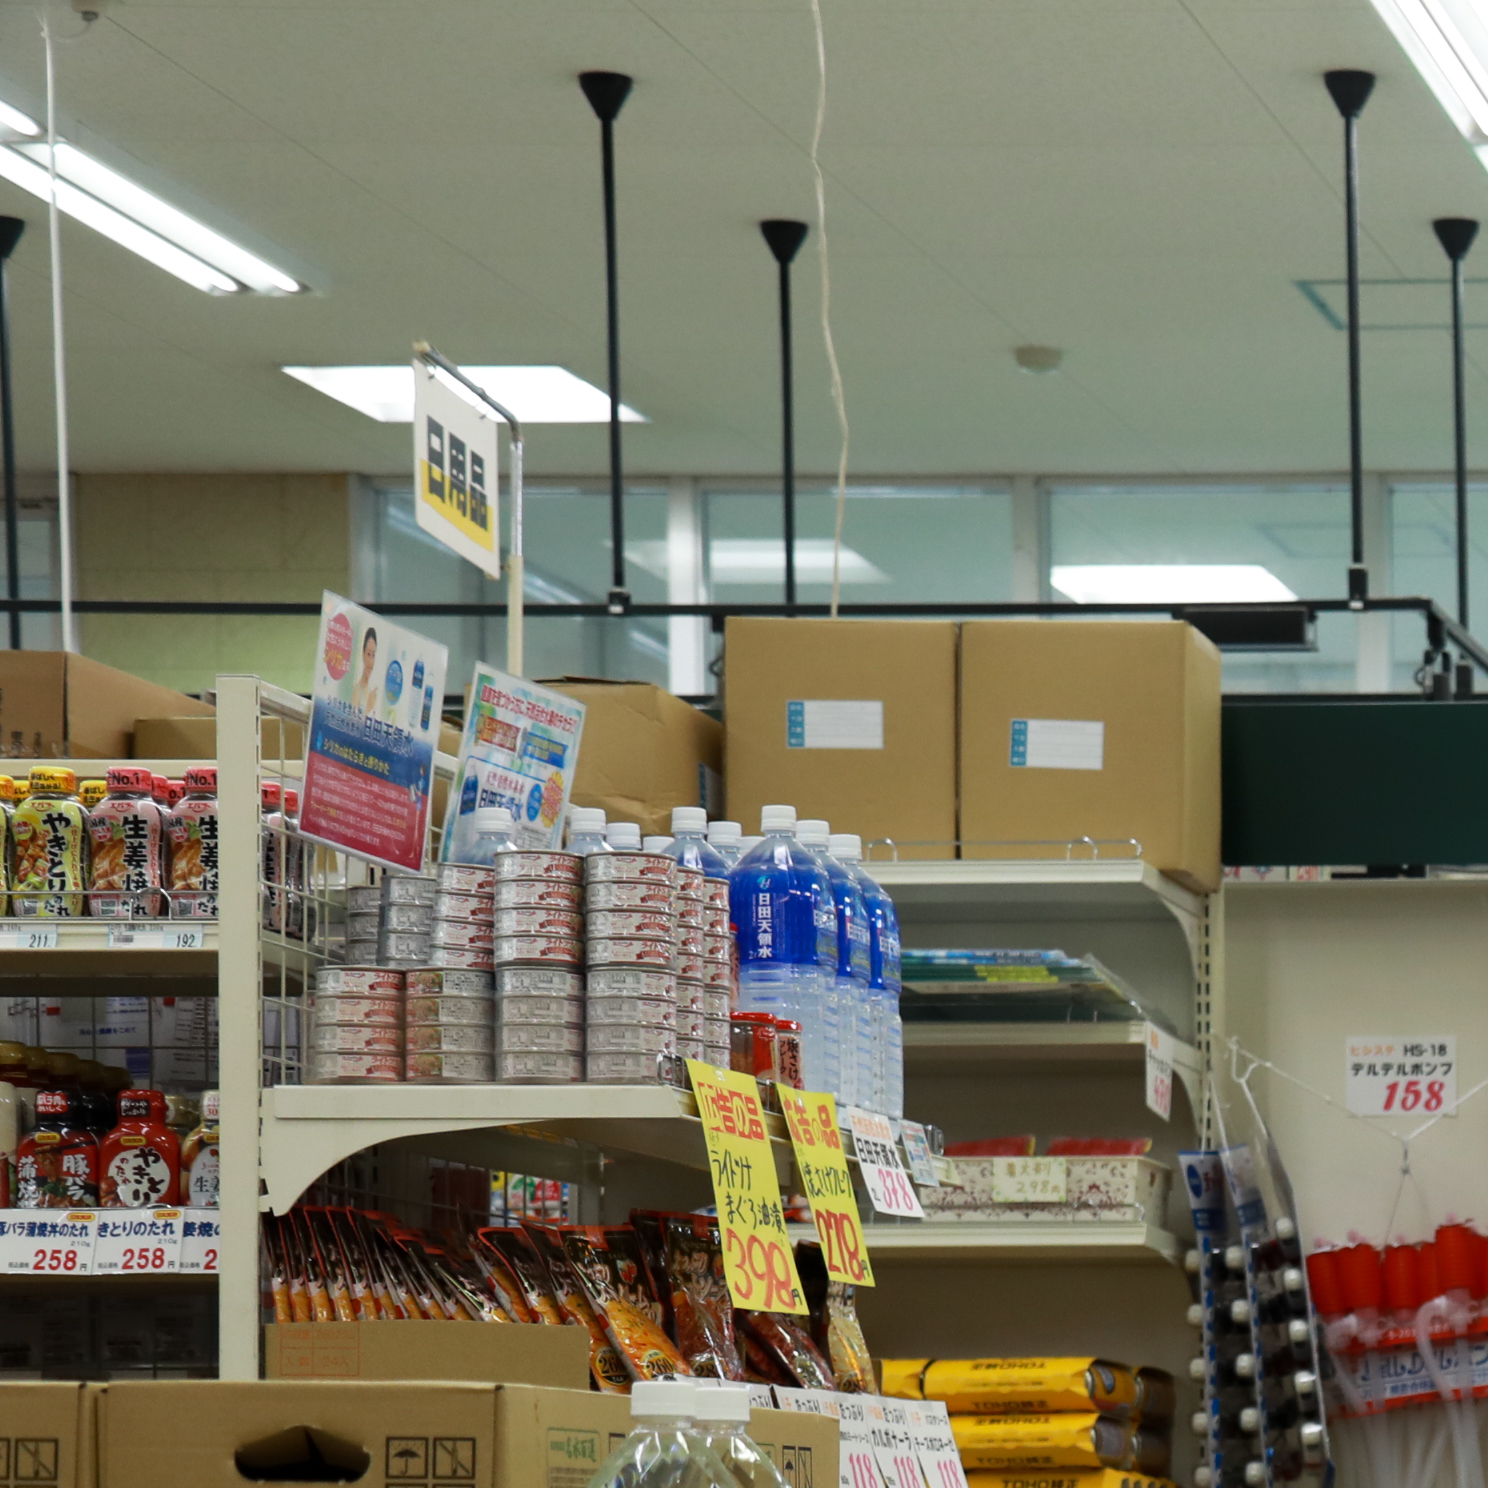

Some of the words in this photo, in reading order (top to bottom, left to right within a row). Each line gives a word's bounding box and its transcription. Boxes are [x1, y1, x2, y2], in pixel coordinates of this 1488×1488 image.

[427, 414, 488, 532] 日用品
[758, 892, 773, 959] 日田天領水
[28, 934, 49, 948] 211
[176, 933, 196, 948] 192
[1383, 1080, 1445, 1113] 158
[815, 1208, 863, 1282] 278
[32, 1249, 78, 1271] 258
[80, 1262, 88, 1272] 円
[121, 1248, 166, 1271] 258
[168, 1260, 176, 1269] 円
[726, 1226, 797, 1310] 398
[871, 1428, 913, 1451] カルボナーラ
